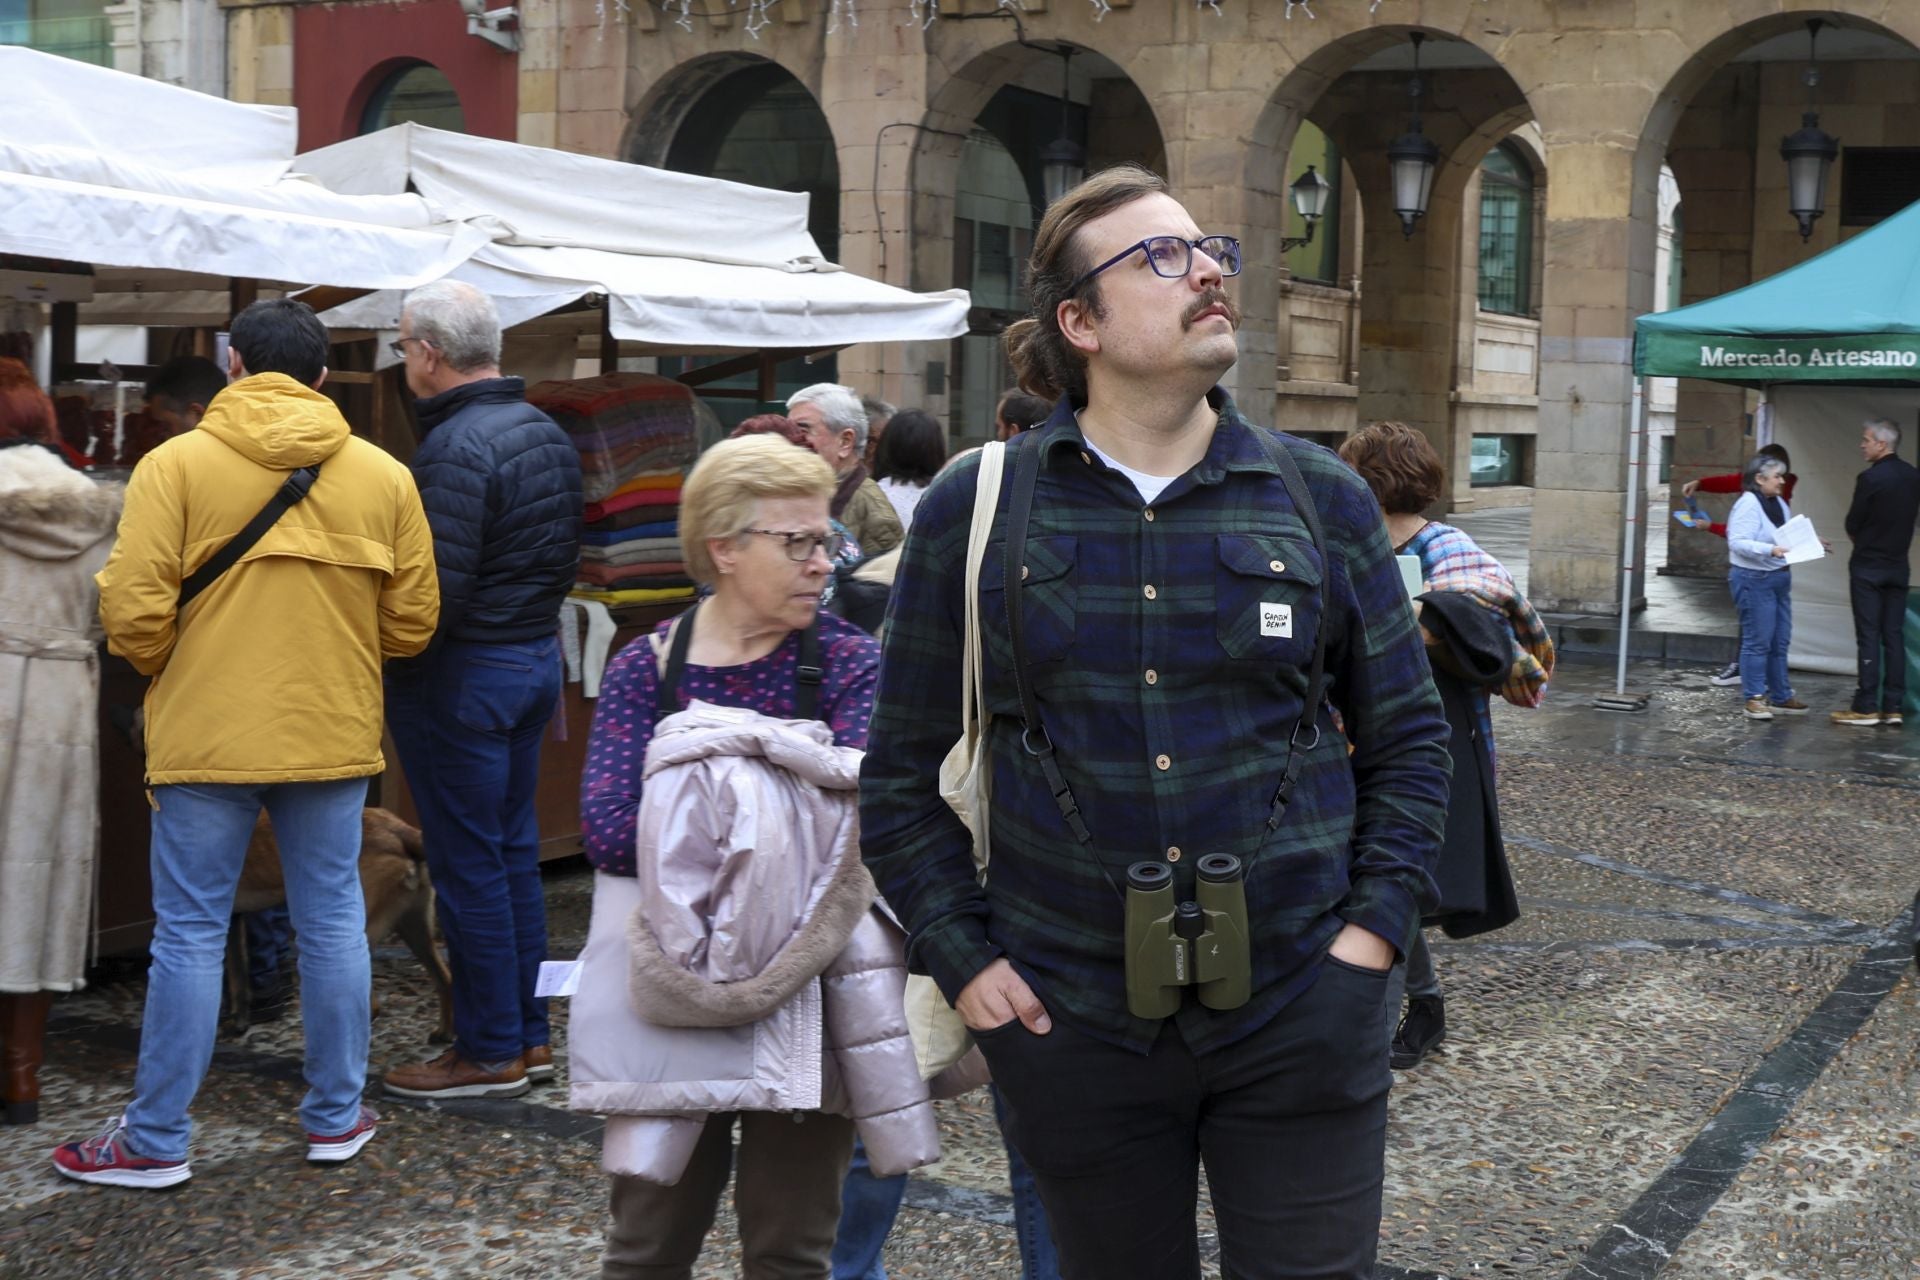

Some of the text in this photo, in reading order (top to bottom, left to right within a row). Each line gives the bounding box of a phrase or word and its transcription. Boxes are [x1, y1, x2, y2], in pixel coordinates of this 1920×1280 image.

[1700, 346, 1917, 367] Mercado Artesano
[1266, 620, 1286, 628] DENIM
